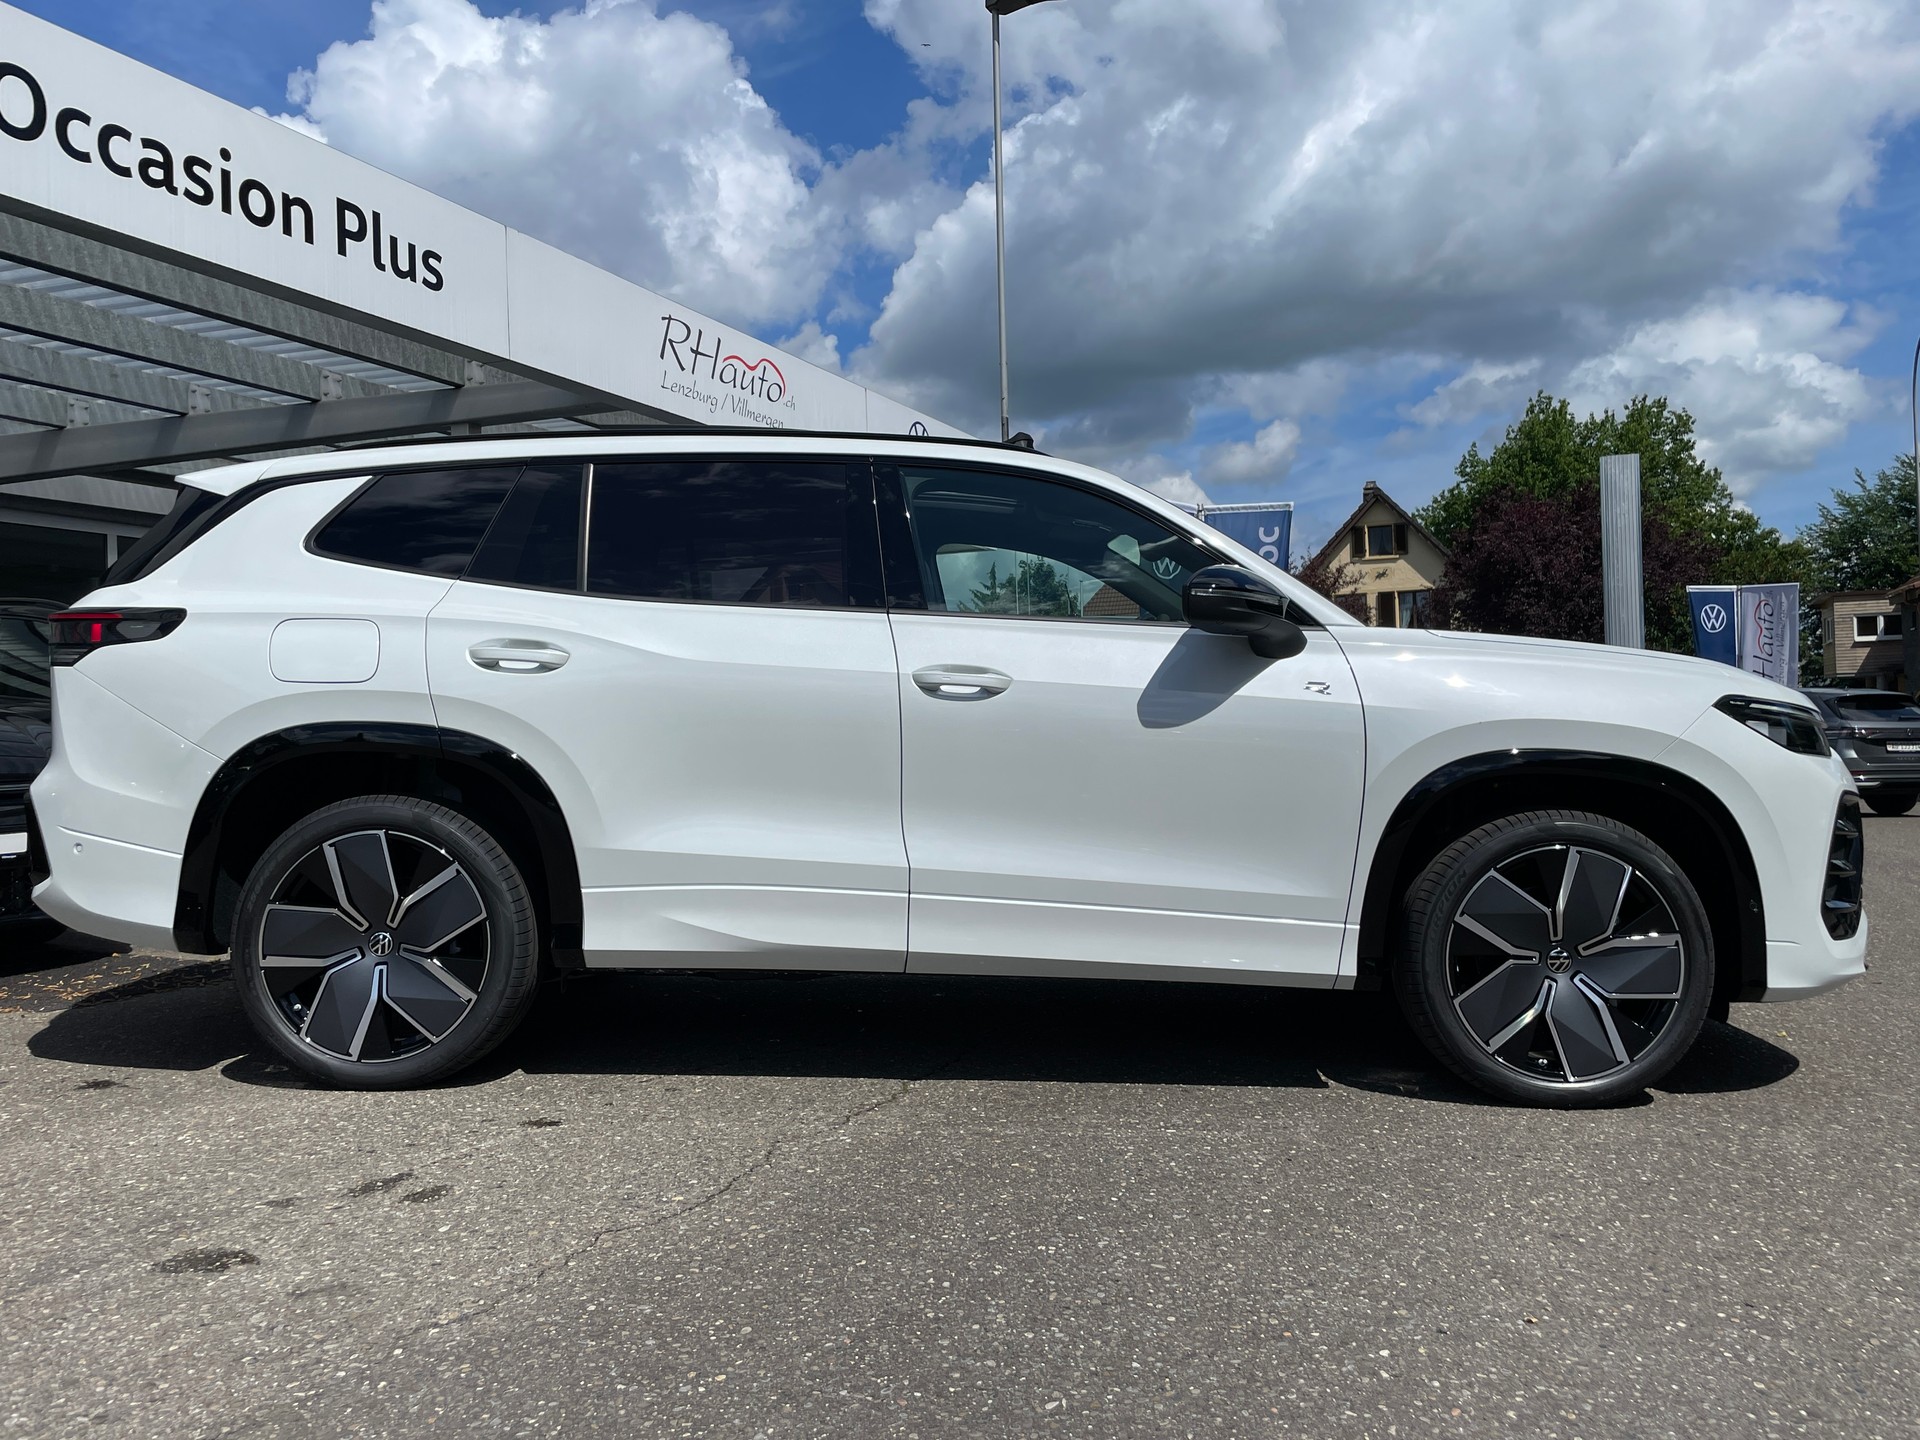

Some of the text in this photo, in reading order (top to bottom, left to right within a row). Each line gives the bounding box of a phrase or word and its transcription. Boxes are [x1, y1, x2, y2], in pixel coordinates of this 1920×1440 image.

[0, 61, 444, 291] Occasion Plus
[660, 370, 718, 414] Lenzburg
